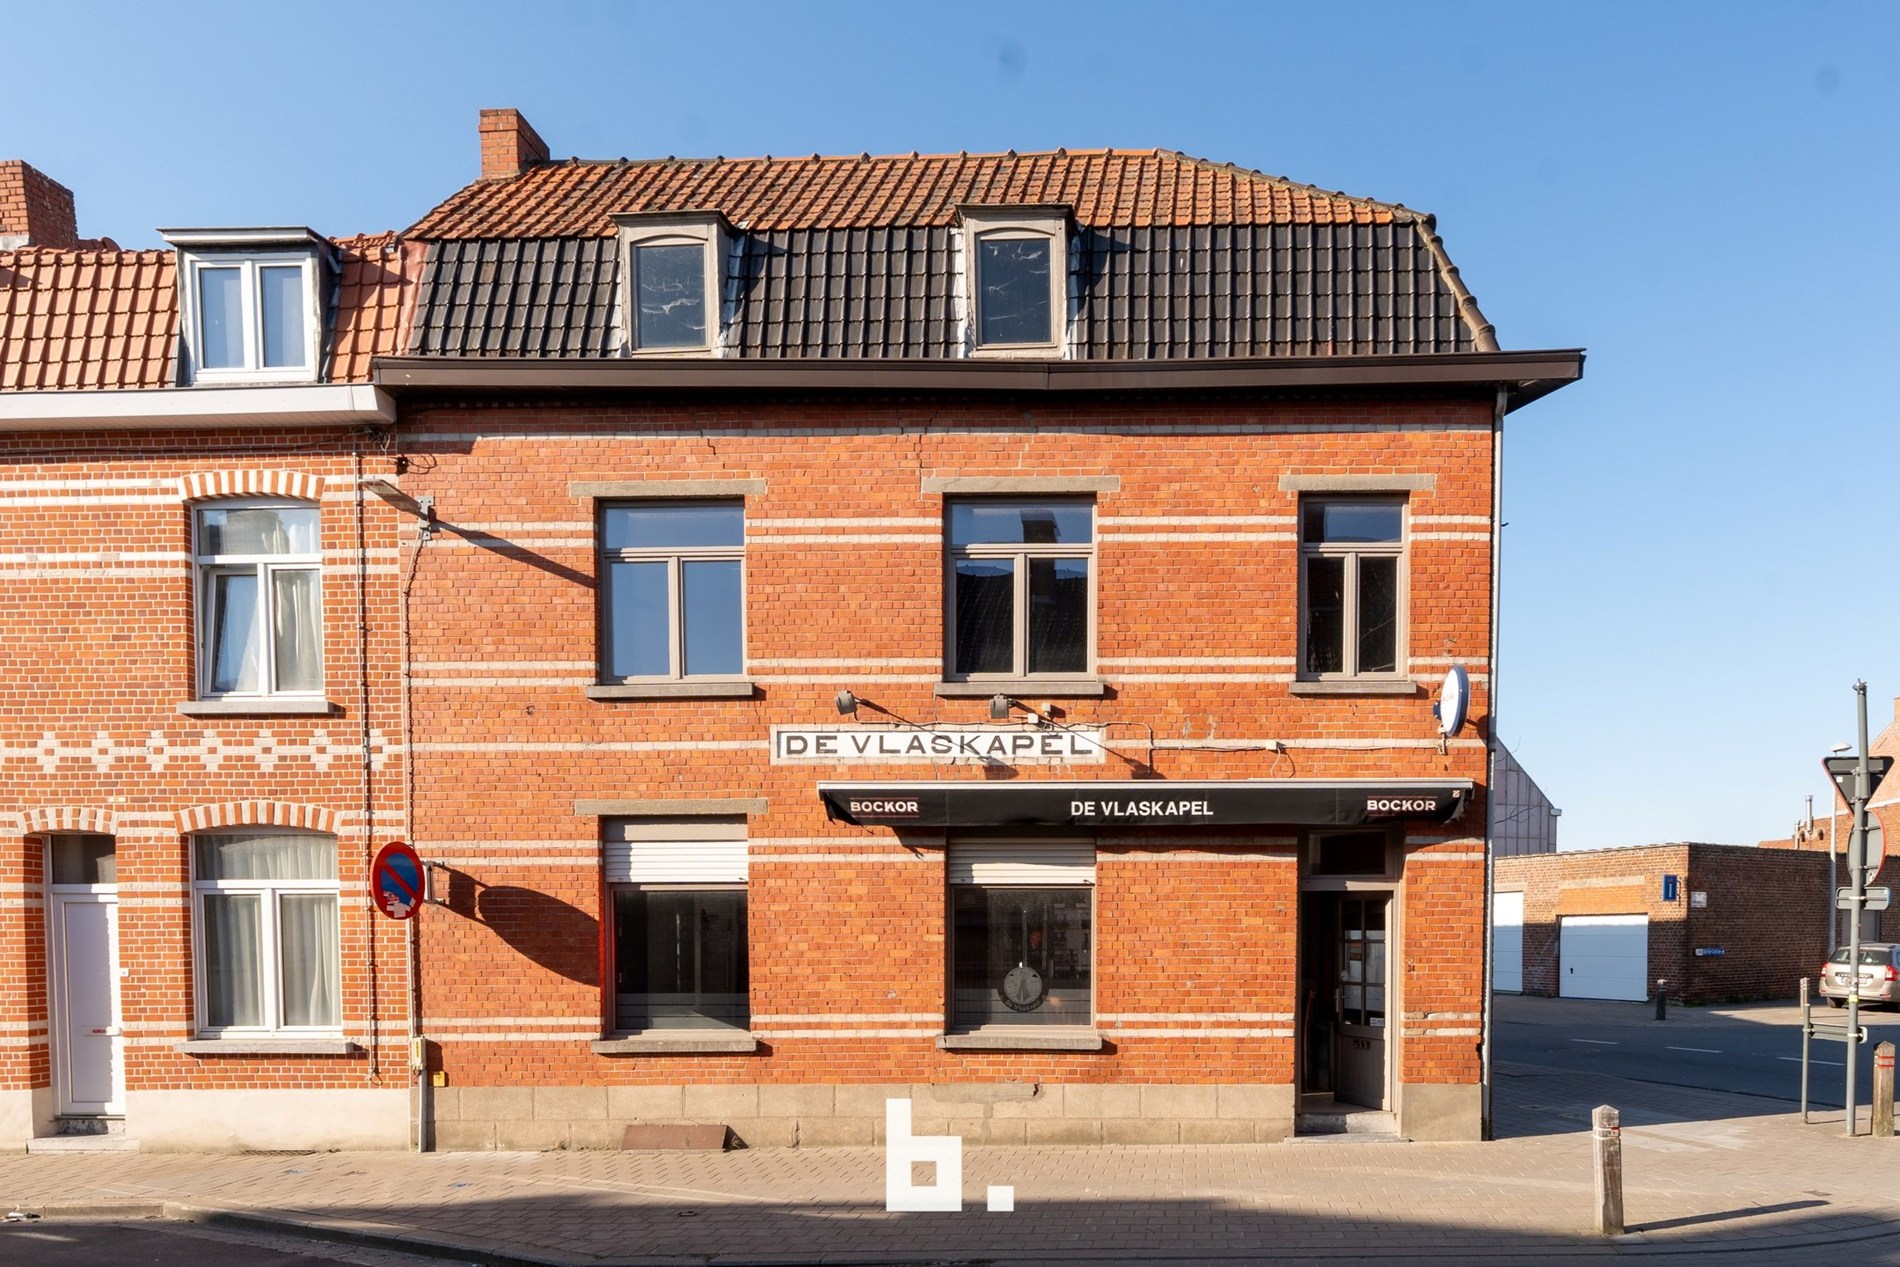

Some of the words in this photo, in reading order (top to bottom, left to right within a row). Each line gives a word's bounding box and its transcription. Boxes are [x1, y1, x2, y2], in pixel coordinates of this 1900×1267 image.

[786, 735, 838, 755] DE
[850, 734, 1093, 755] VLASKAPEL
[850, 801, 919, 812] BOCKOR
[1071, 801, 1096, 816] DE
[1101, 801, 1214, 816] VLASKAPEL
[1367, 800, 1436, 811] BOCKOR
